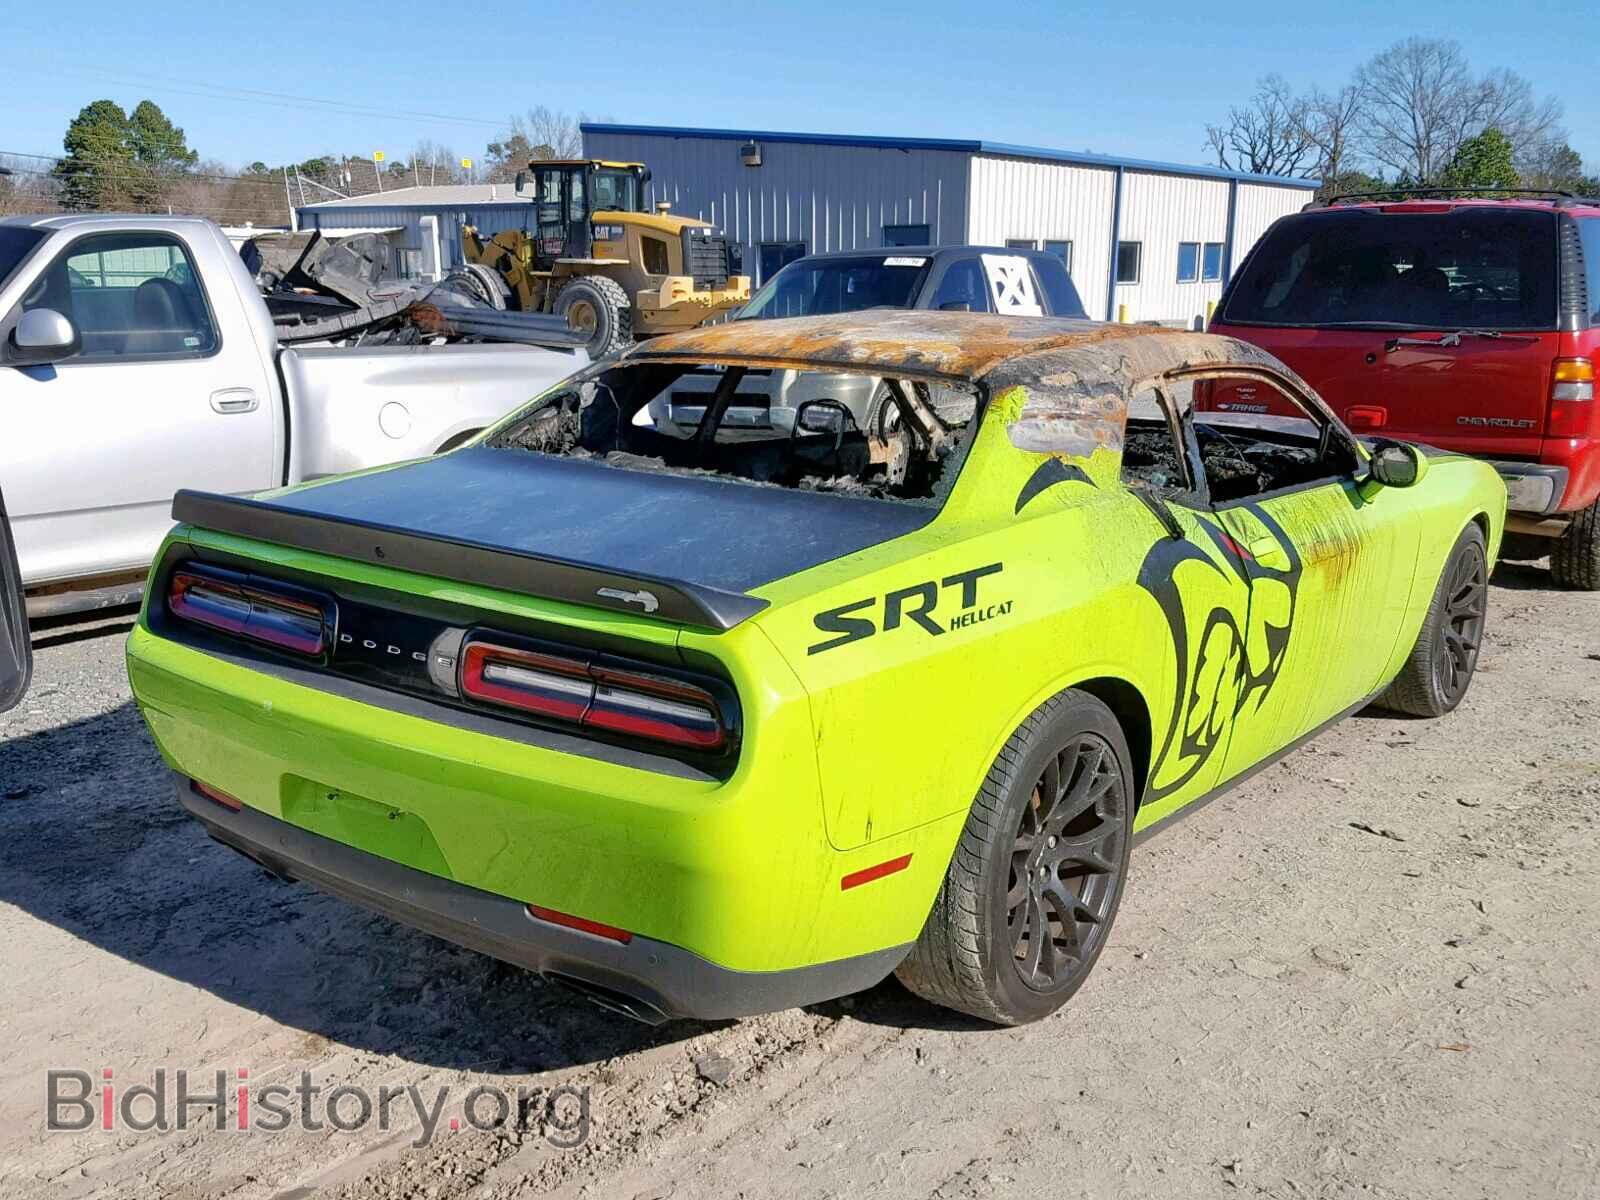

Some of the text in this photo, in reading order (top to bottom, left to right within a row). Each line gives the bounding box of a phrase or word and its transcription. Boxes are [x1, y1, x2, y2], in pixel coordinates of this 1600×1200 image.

[594, 226, 609, 240] CAT
[1456, 416, 1536, 428] CHEVROLET
[807, 561, 1003, 656] SRT
[950, 600, 1013, 632] HELLCAT
[340, 633, 453, 669] DODGE
